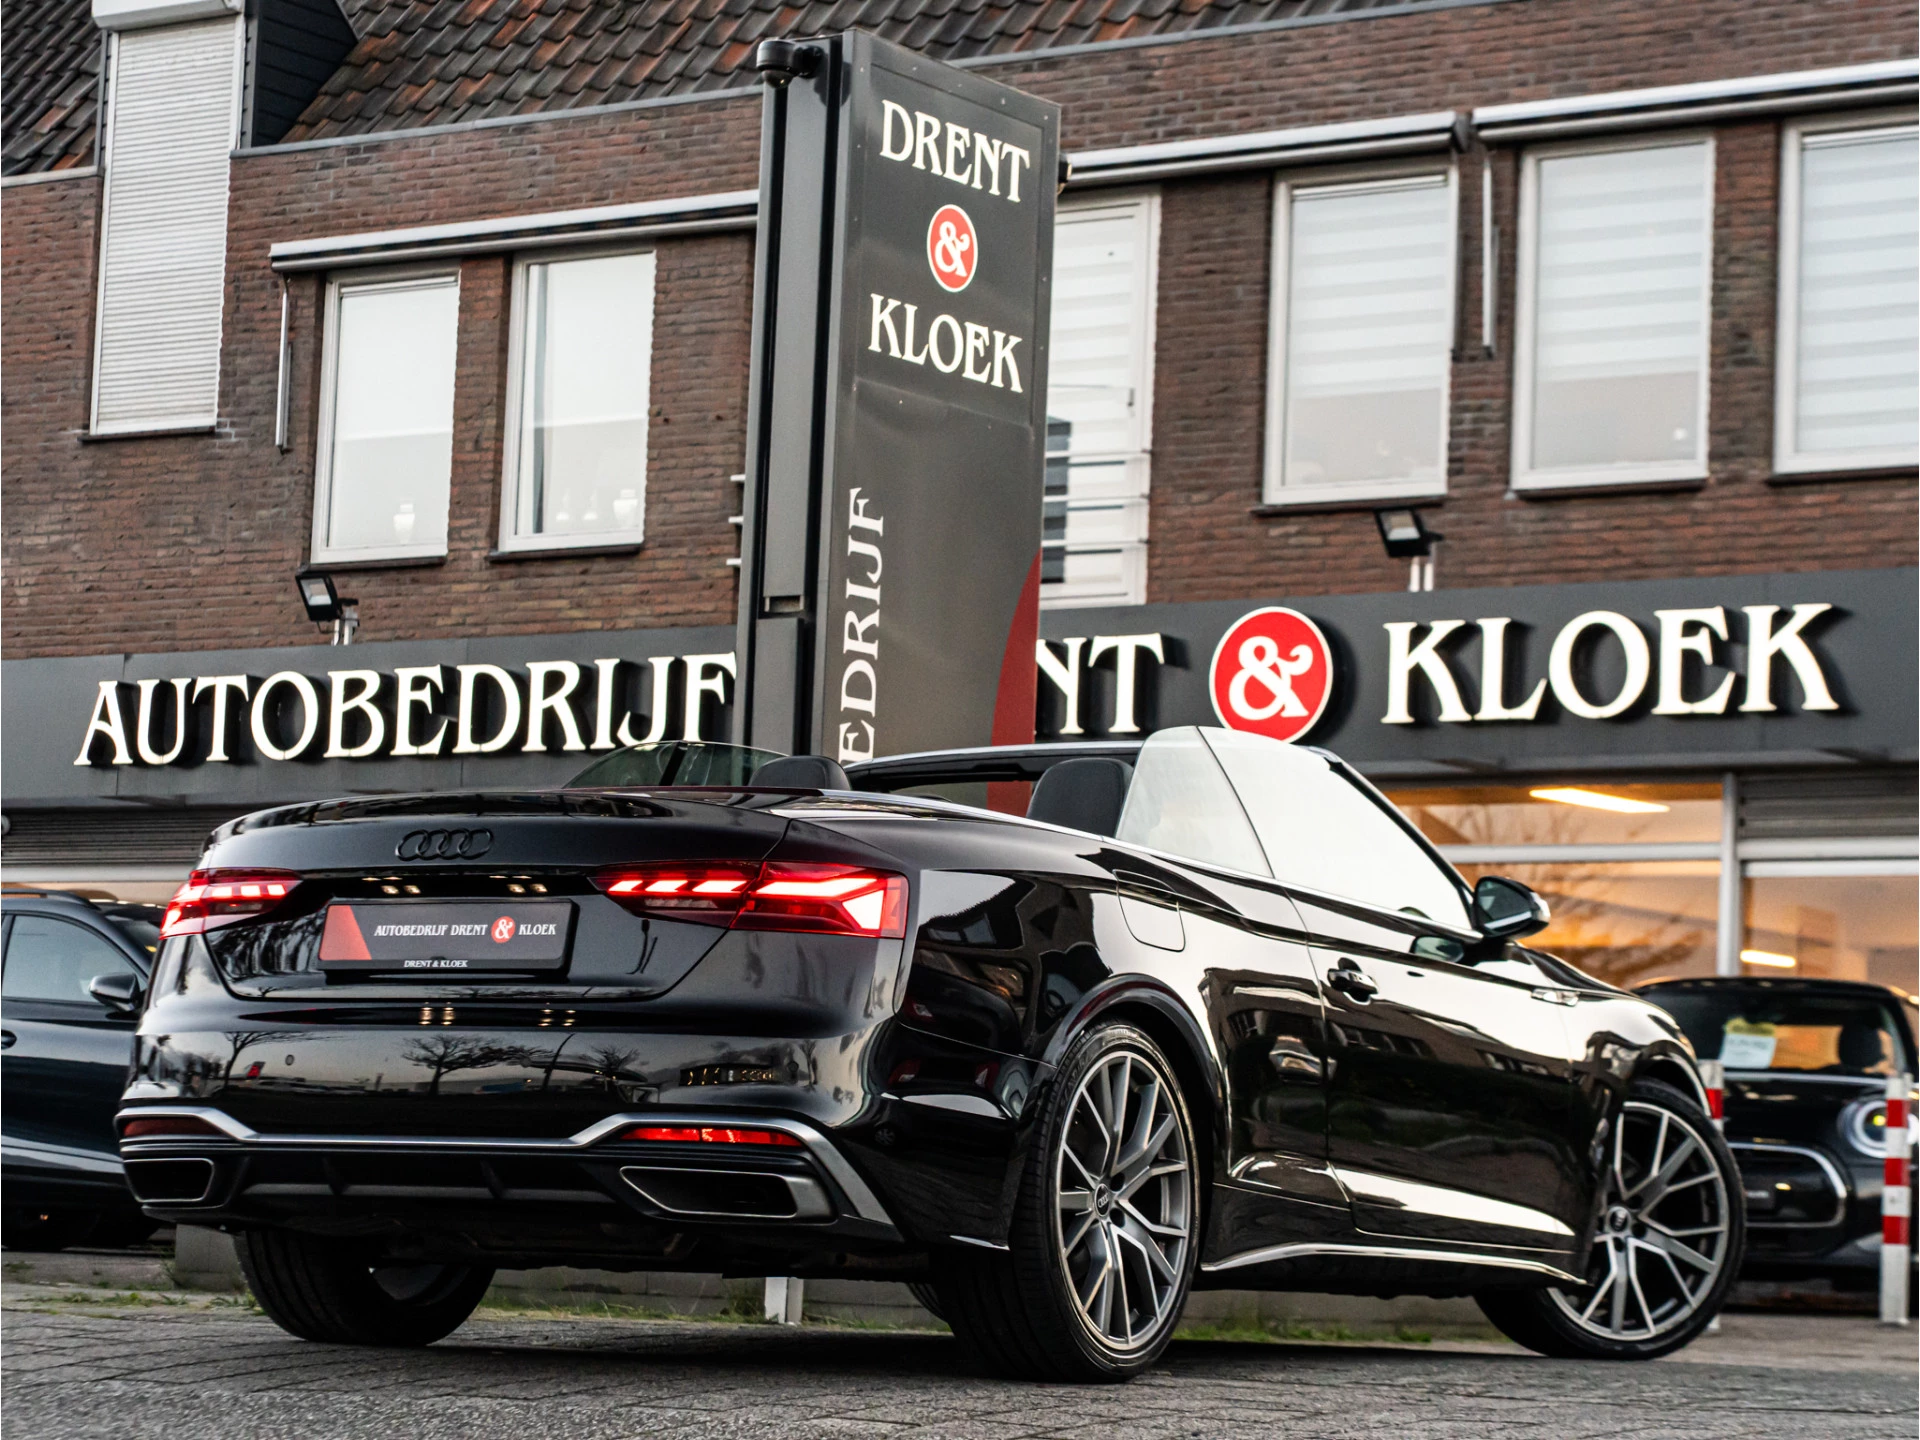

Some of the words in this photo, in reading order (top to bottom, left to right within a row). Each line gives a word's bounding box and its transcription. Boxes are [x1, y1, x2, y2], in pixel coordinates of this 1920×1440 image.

[879, 99, 1031, 202] DRENT
[935, 221, 970, 277] &
[868, 293, 1024, 394] KLOEK
[73, 651, 737, 767] AUTOBEDRIJF
[1229, 635, 1313, 720] &
[1381, 602, 1841, 725] KLOEK
[373, 924, 449, 937] AUTOBEDRIJF
[450, 924, 488, 936] DRENT
[494, 918, 514, 940] &
[518, 923, 557, 936] KLOEK
[403, 959, 432, 968] DRENT
[440, 959, 469, 968] KLOEK
